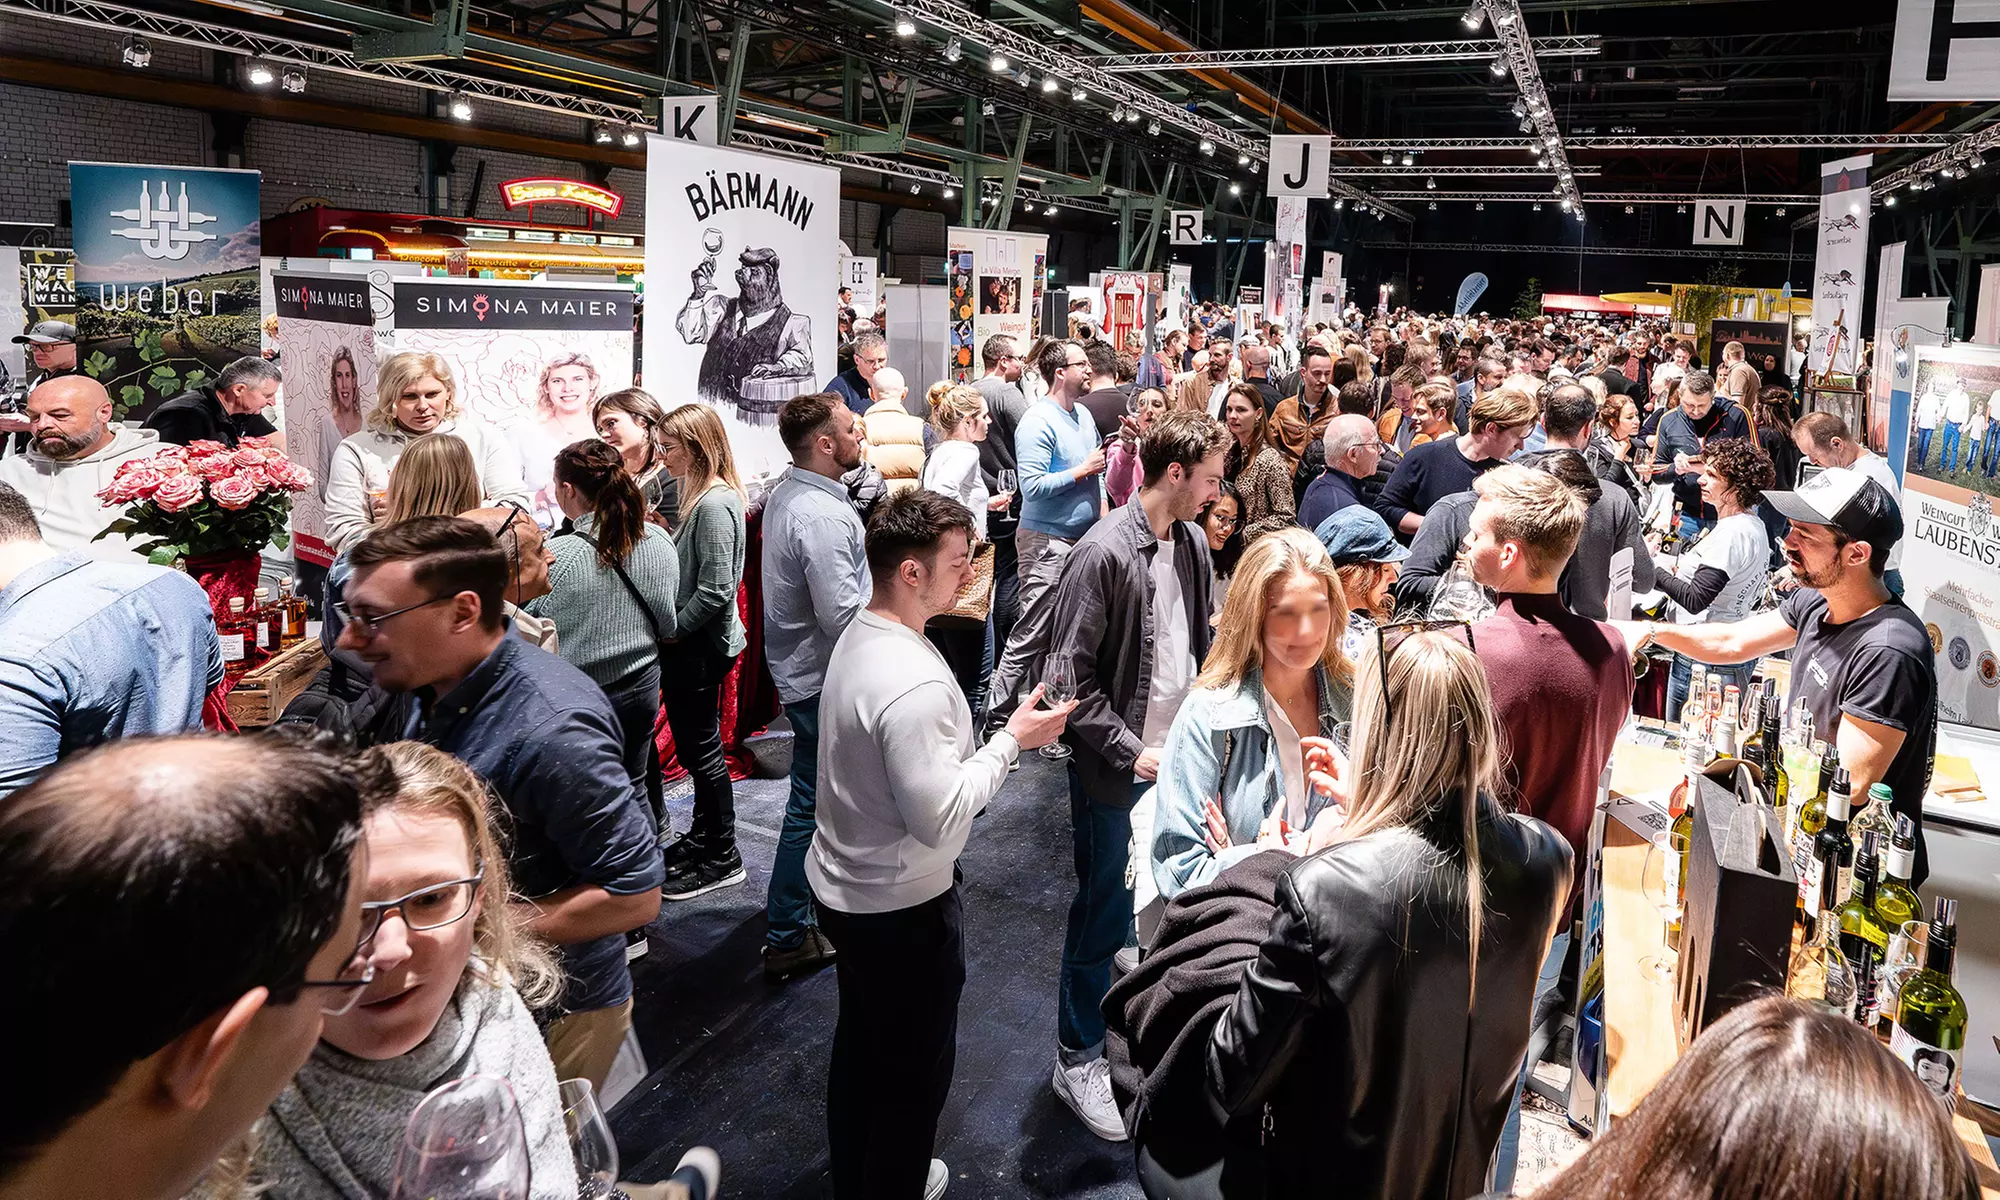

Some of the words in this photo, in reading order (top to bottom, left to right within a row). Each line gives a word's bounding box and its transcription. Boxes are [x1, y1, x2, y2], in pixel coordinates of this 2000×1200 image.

[674, 105, 706, 142] K
[1283, 142, 1310, 190] J
[684, 169, 814, 232] BÄRMANN
[1175, 214, 1198, 242] R
[1703, 204, 1735, 239] N
[33, 266, 67, 280] WE
[35, 294, 76, 302] WEIN
[100, 276, 228, 317] weber
[328, 291, 364, 309] MAIER
[541, 301, 617, 316] MAIER
[977, 326, 991, 337] Bio
[1000, 322, 1027, 334] Weingut
[1921, 501, 1966, 528] WEINGUT
[1915, 519, 2000, 568] LAUBENS
[1946, 580, 1995, 608] Mehrfacher
